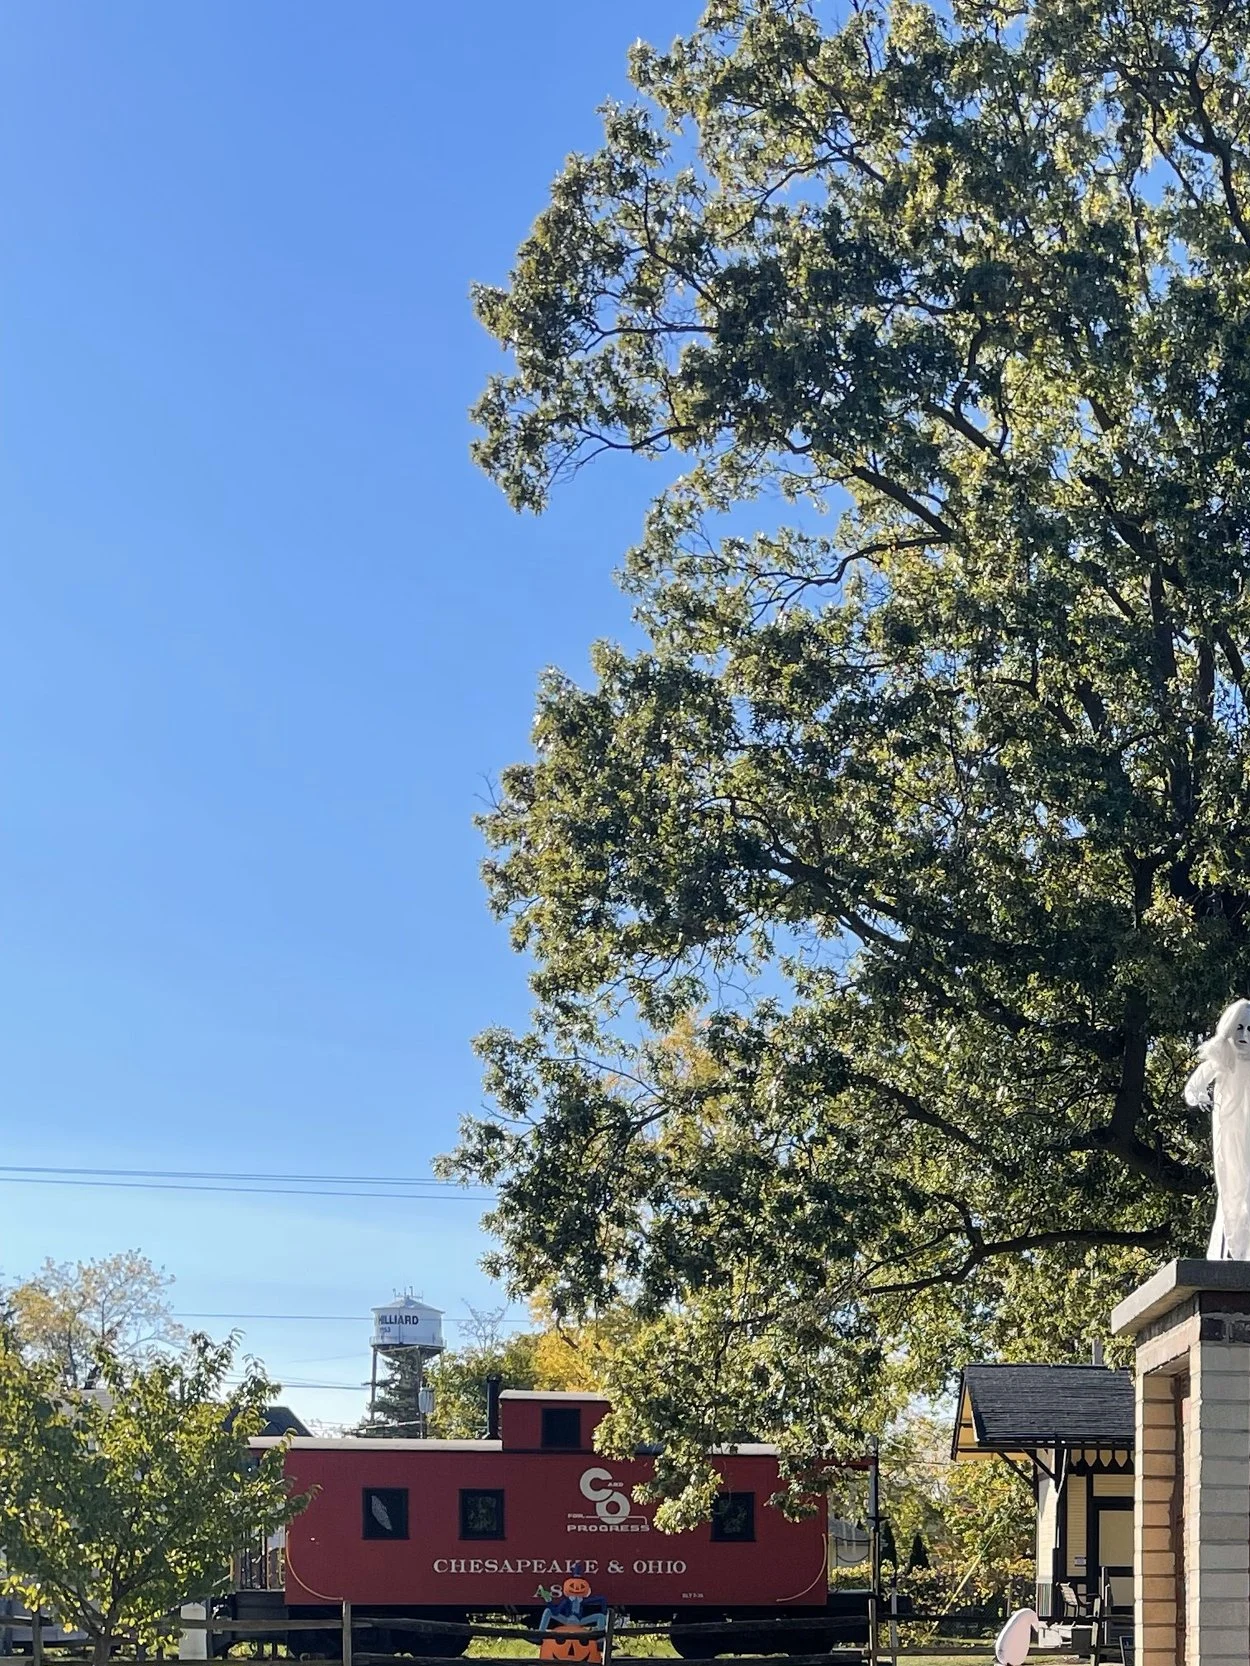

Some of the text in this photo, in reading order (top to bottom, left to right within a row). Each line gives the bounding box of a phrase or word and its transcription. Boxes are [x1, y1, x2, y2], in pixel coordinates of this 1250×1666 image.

[380, 1315, 419, 1325] HILLIARD
[433, 1559, 687, 1574] CHESAPEAKE & OHIO
